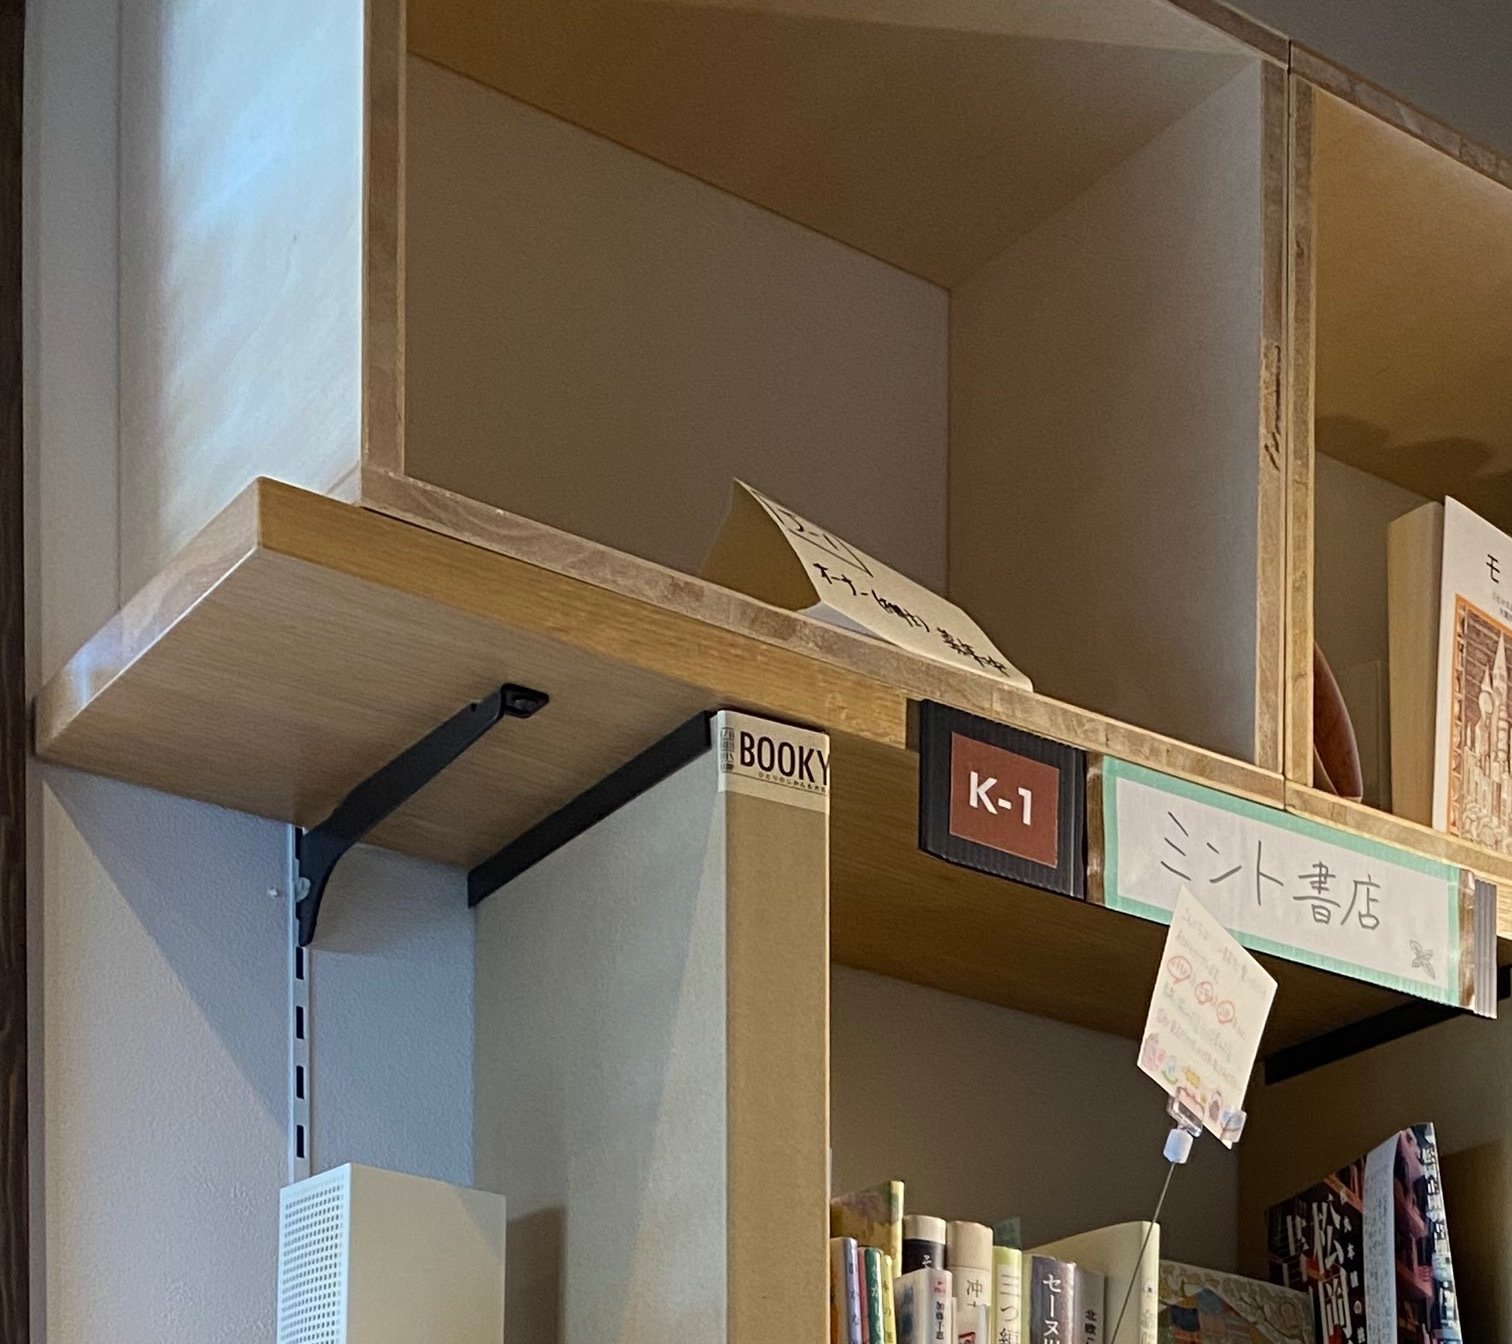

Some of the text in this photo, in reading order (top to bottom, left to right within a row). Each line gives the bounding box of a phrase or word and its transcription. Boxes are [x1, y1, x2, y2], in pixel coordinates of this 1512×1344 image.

[969, 771, 1032, 825] K-1
[1160, 811, 1381, 931] ミント書店
